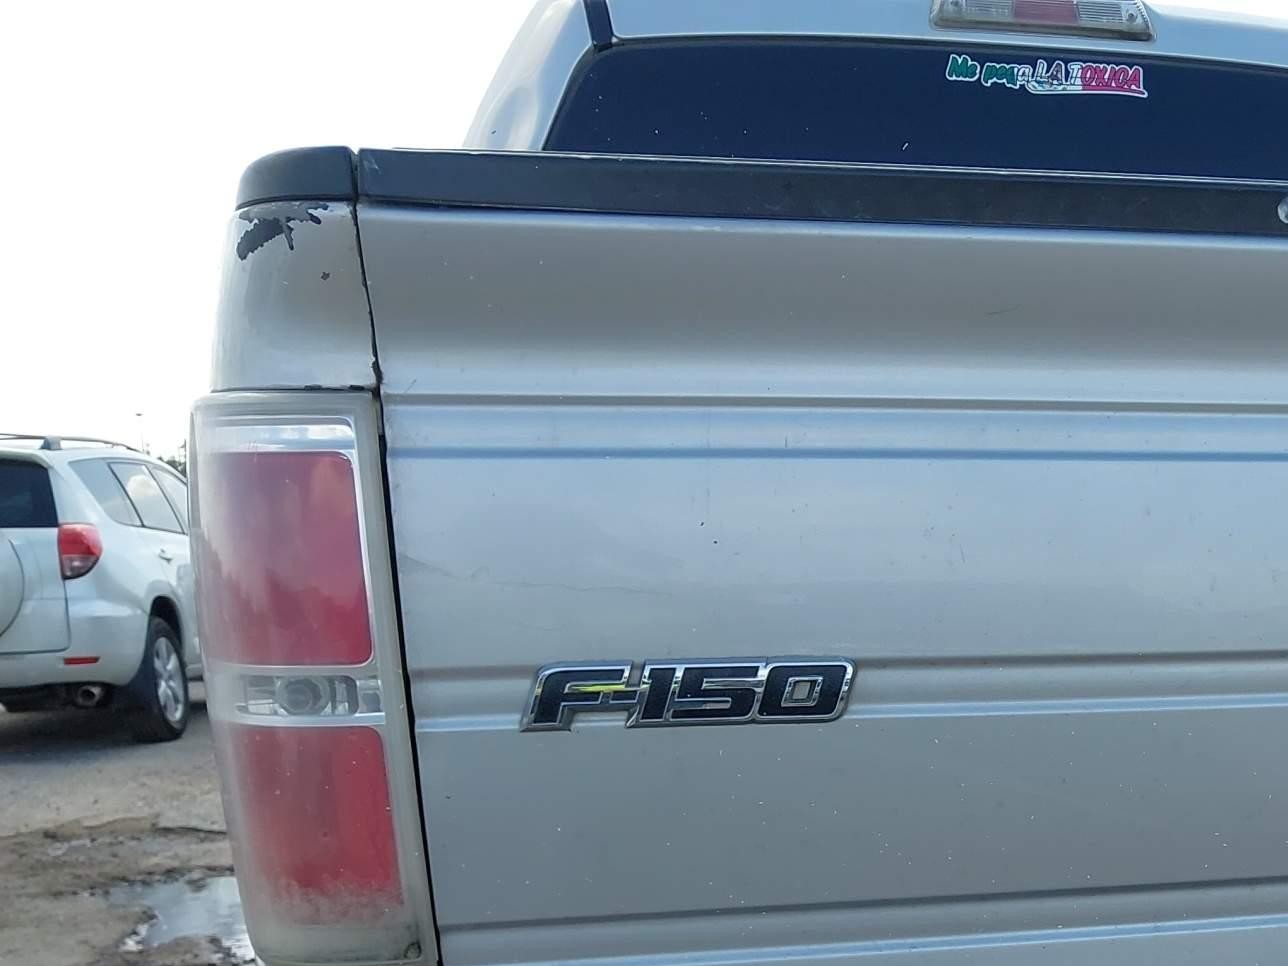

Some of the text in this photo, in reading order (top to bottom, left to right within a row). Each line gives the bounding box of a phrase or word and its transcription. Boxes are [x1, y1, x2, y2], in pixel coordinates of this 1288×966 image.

[947, 55, 980, 81] Me
[1031, 60, 1064, 86] LA
[1066, 62, 1144, 90] TOXICA
[521, 657, 857, 733] F-150
